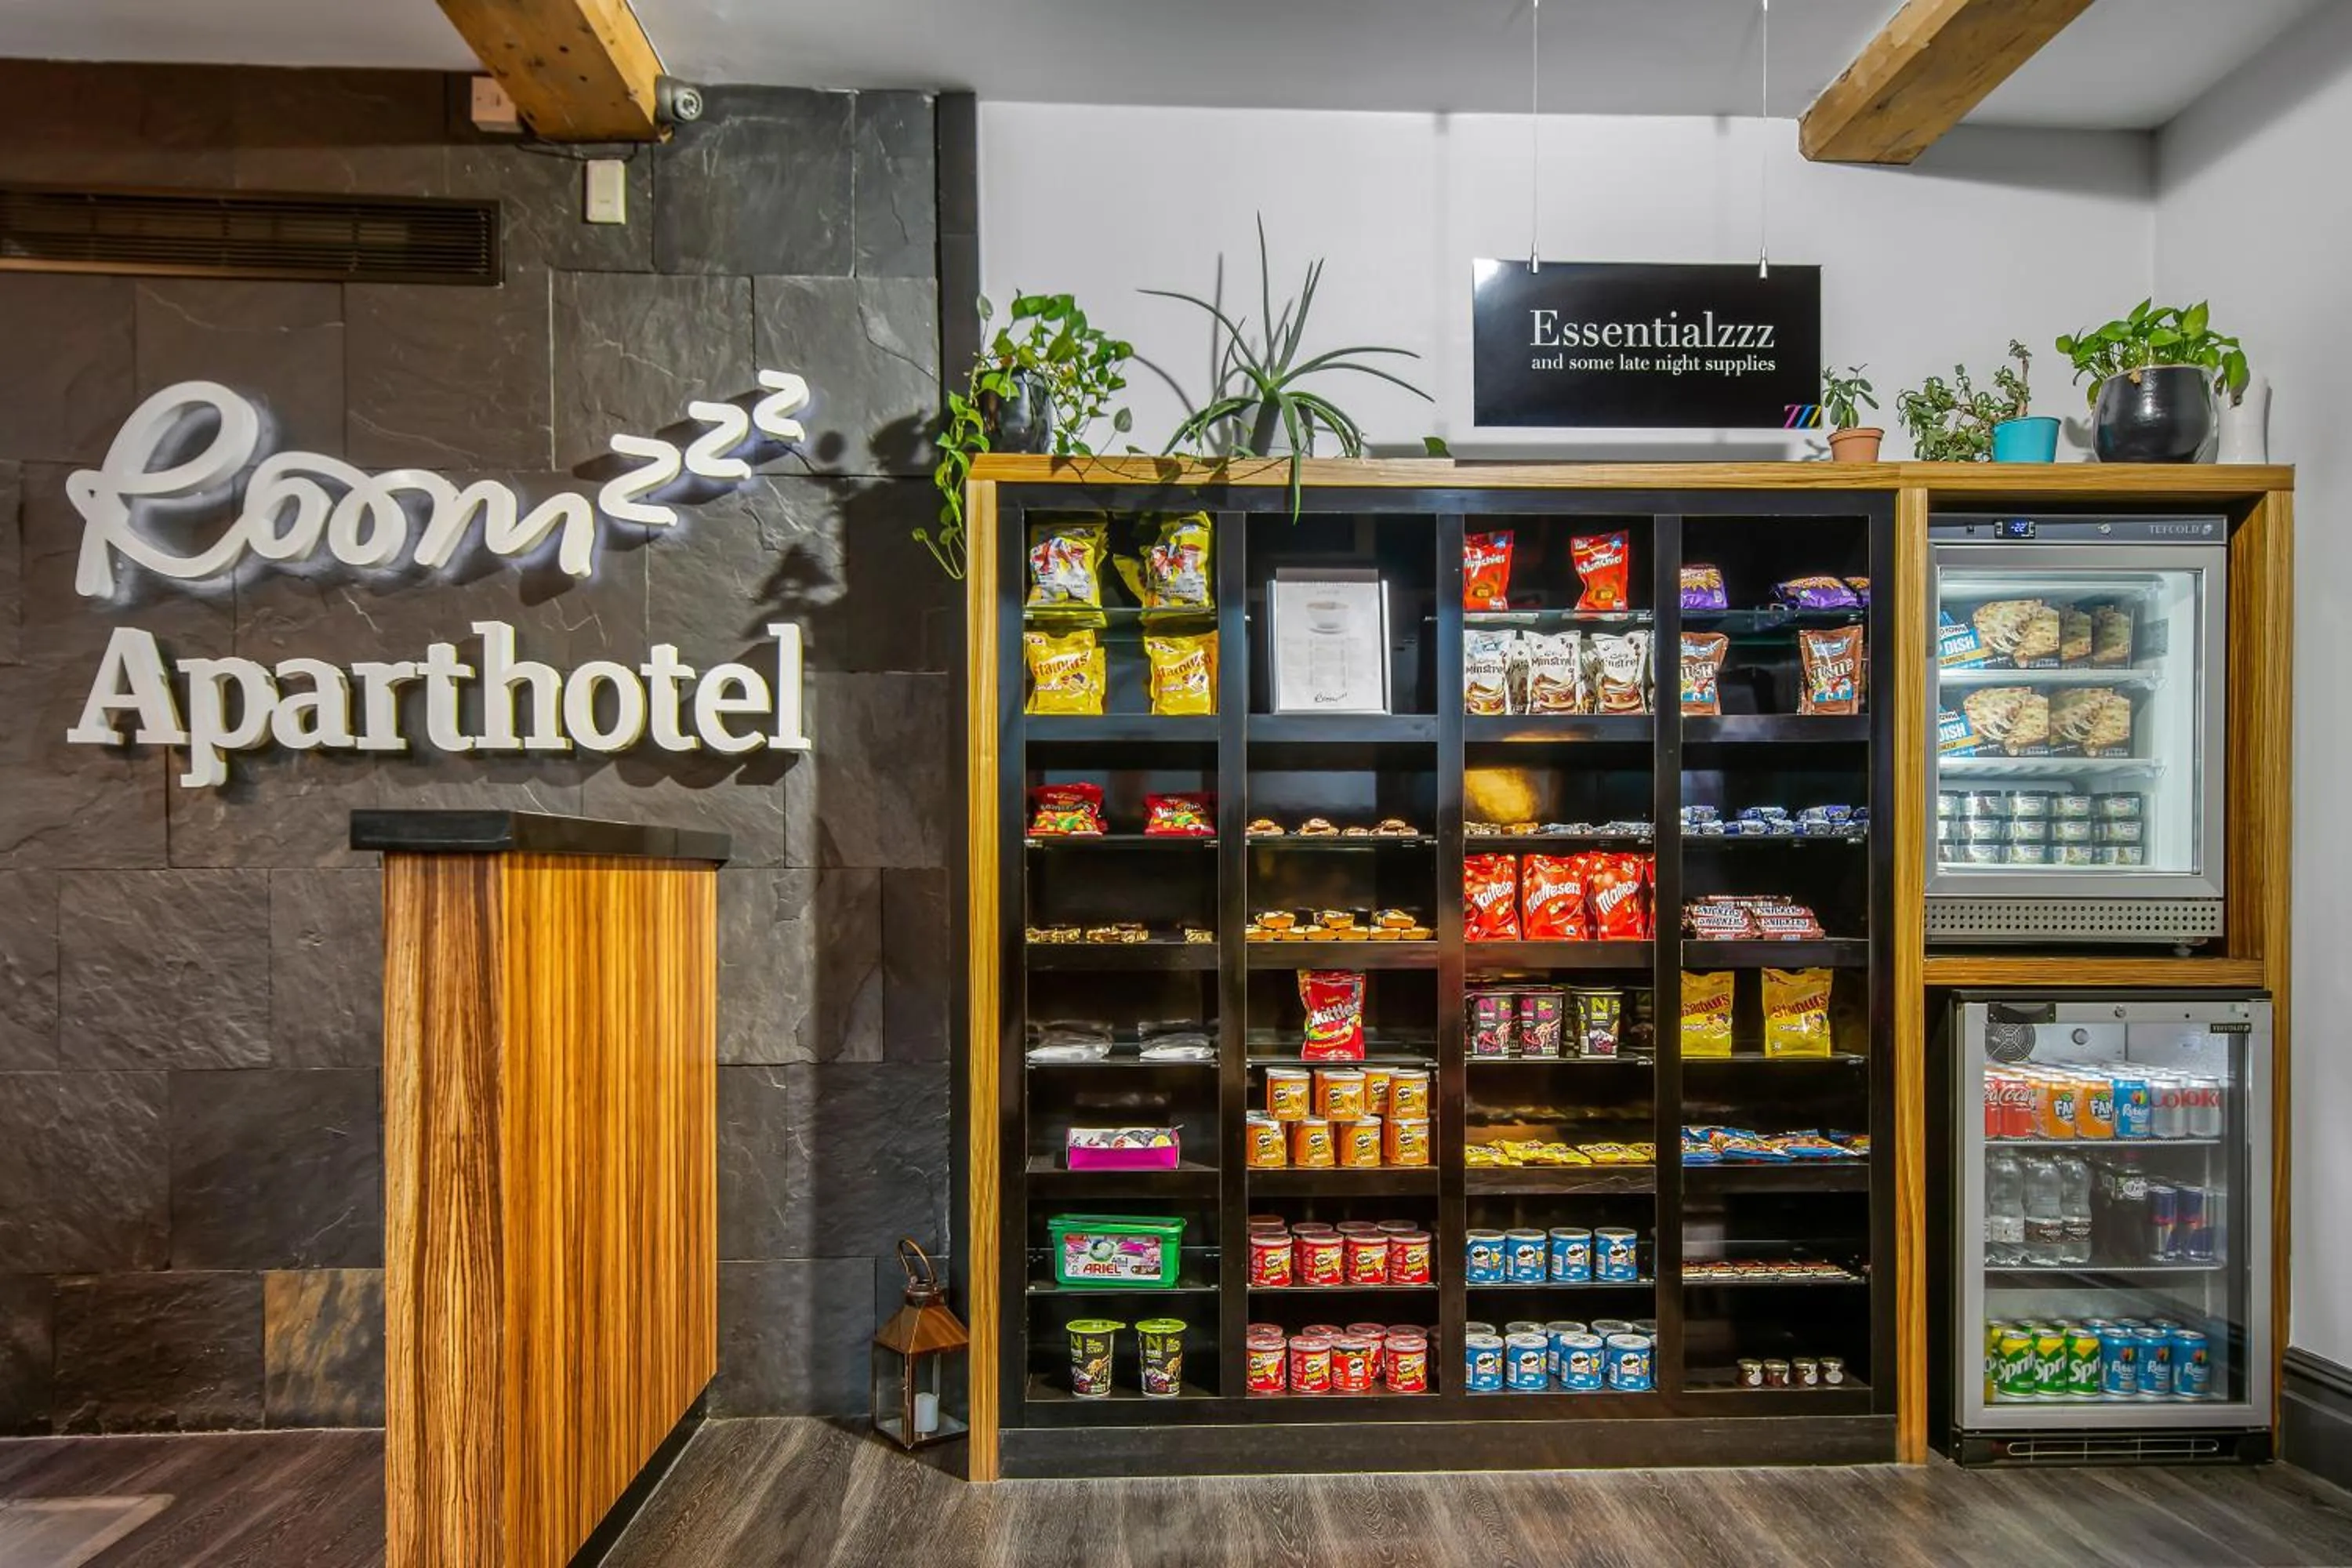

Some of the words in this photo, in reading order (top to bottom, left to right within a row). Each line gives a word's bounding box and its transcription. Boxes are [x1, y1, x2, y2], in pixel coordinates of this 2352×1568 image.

[1530, 310, 1775, 348] Essentialzzz
[1531, 353, 1563, 370] and
[1569, 357, 1614, 370] some
[1620, 354, 1650, 371] late
[1655, 354, 1700, 376] night
[1705, 355, 1776, 376] supplies
[1944, 634, 1976, 656] DISH
[67, 621, 811, 787] Aparthotel
[1083, 1263, 1122, 1274] ARIEL
